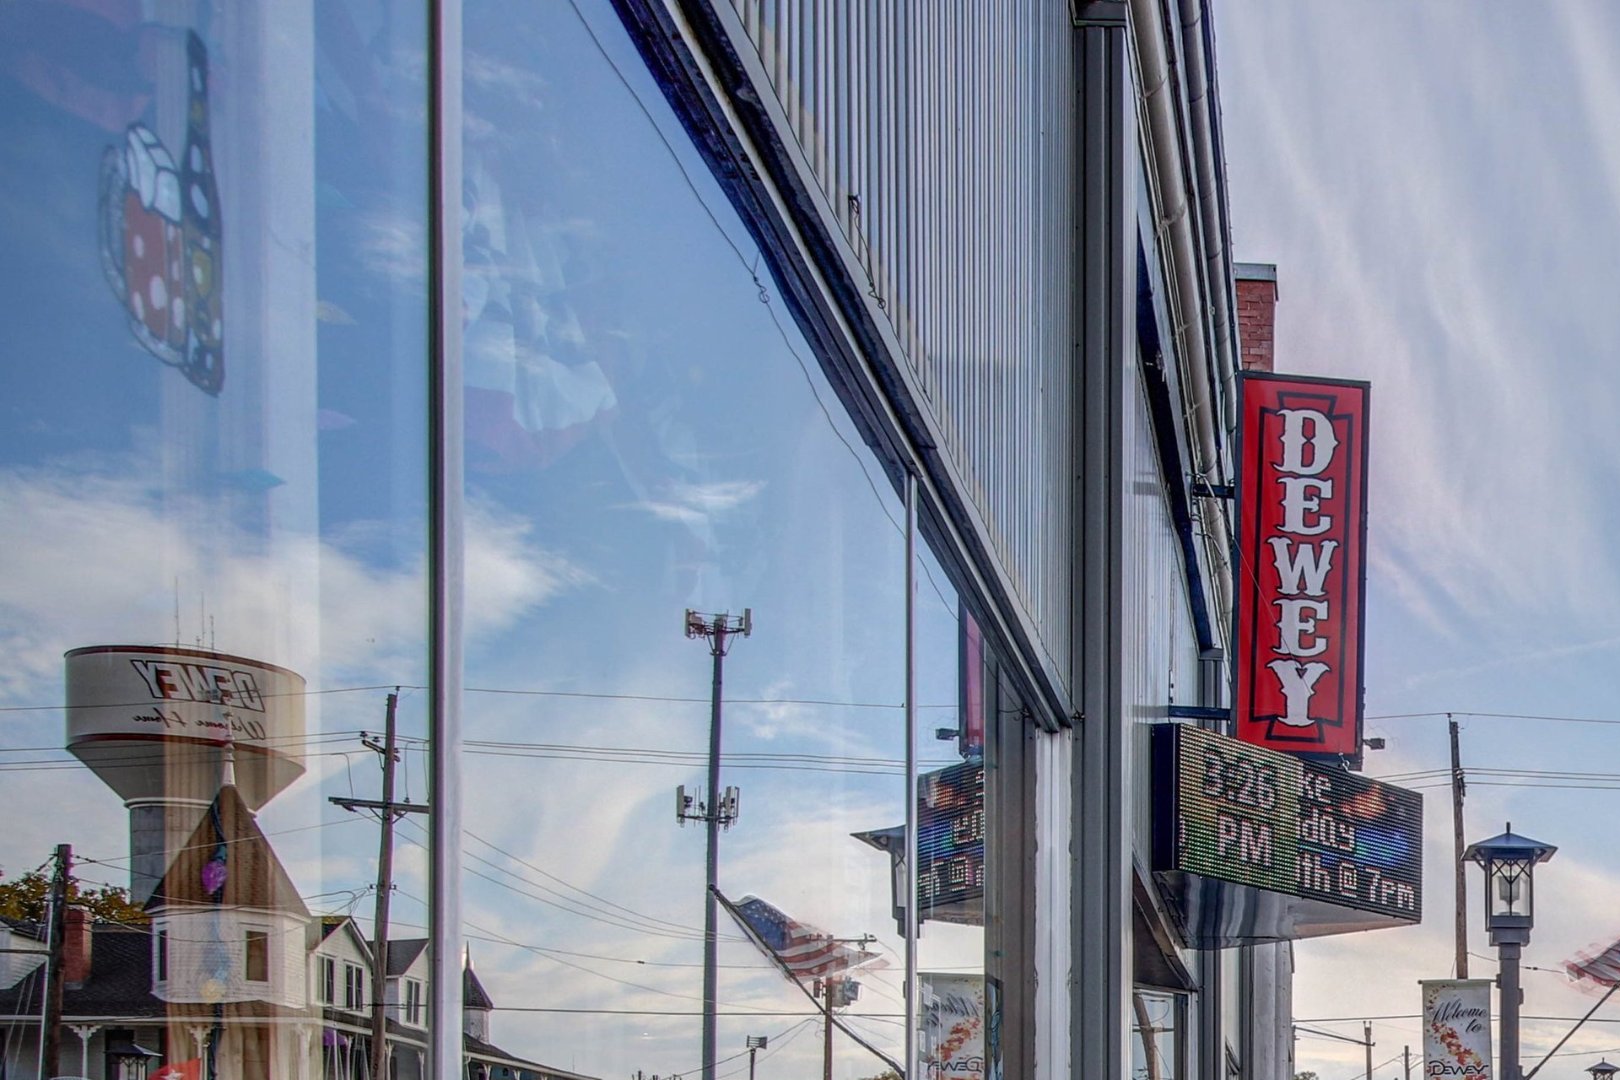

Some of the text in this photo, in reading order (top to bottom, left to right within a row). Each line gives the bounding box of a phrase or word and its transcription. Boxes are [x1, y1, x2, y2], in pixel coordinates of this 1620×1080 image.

[1266, 408, 1339, 727] DEWEY
[1217, 811, 1272, 867] PM
[1432, 998, 1487, 1022] Welcome
[1465, 1018, 1486, 1033] to
